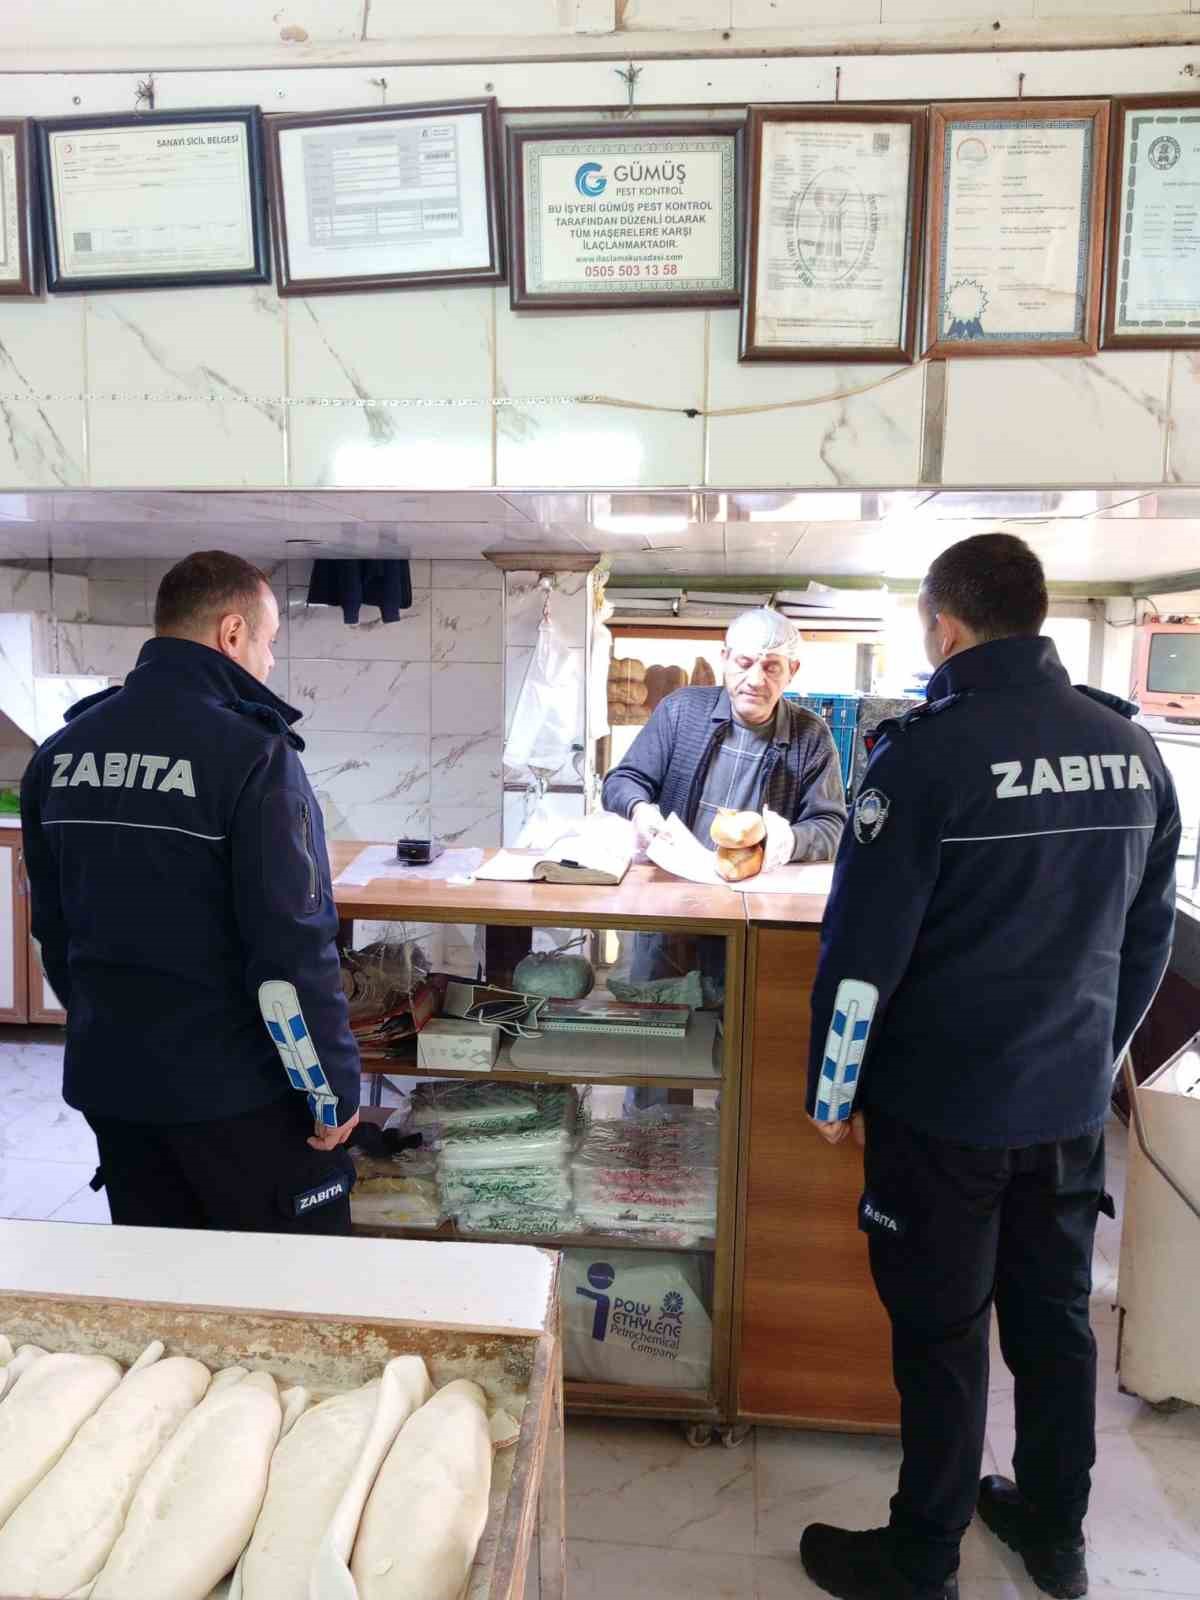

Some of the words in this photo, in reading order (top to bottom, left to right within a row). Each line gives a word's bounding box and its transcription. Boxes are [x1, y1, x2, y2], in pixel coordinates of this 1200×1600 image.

[614, 160, 686, 184] GÜMÜŞ
[616, 187, 636, 197] PEST
[639, 186, 684, 196] KONTROL
[548, 204, 562, 214] BU
[565, 203, 596, 214] İŞYERİ
[598, 202, 635, 214] GÜMÜŞ
[637, 202, 663, 212] PEST
[665, 201, 712, 211] KONTROL
[556, 217, 617, 227] TARAFINDAN
[620, 215, 662, 226] DÜZENLİ
[664, 214, 706, 225] OLARAK
[569, 228, 591, 238] TÜM
[593, 228, 660, 239] HAŞERELERE
[661, 227, 692, 238] KARŞI
[583, 239, 679, 251] İLAÇLANMAKTADIR.
[584, 265, 614, 277] 0505
[618, 264, 640, 276] 503
[645, 264, 658, 275] 13
[663, 263, 678, 275] 58
[51, 752, 196, 798] ZABITA
[990, 754, 1151, 799] ZABITA
[300, 1183, 343, 1209] ZABITA
[864, 1204, 897, 1231] ZABITA
[614, 1297, 651, 1317] POLY
[612, 1312, 683, 1337] ETHYLENE
[609, 1323, 680, 1350] Petrochemical
[631, 1341, 679, 1360] Company
